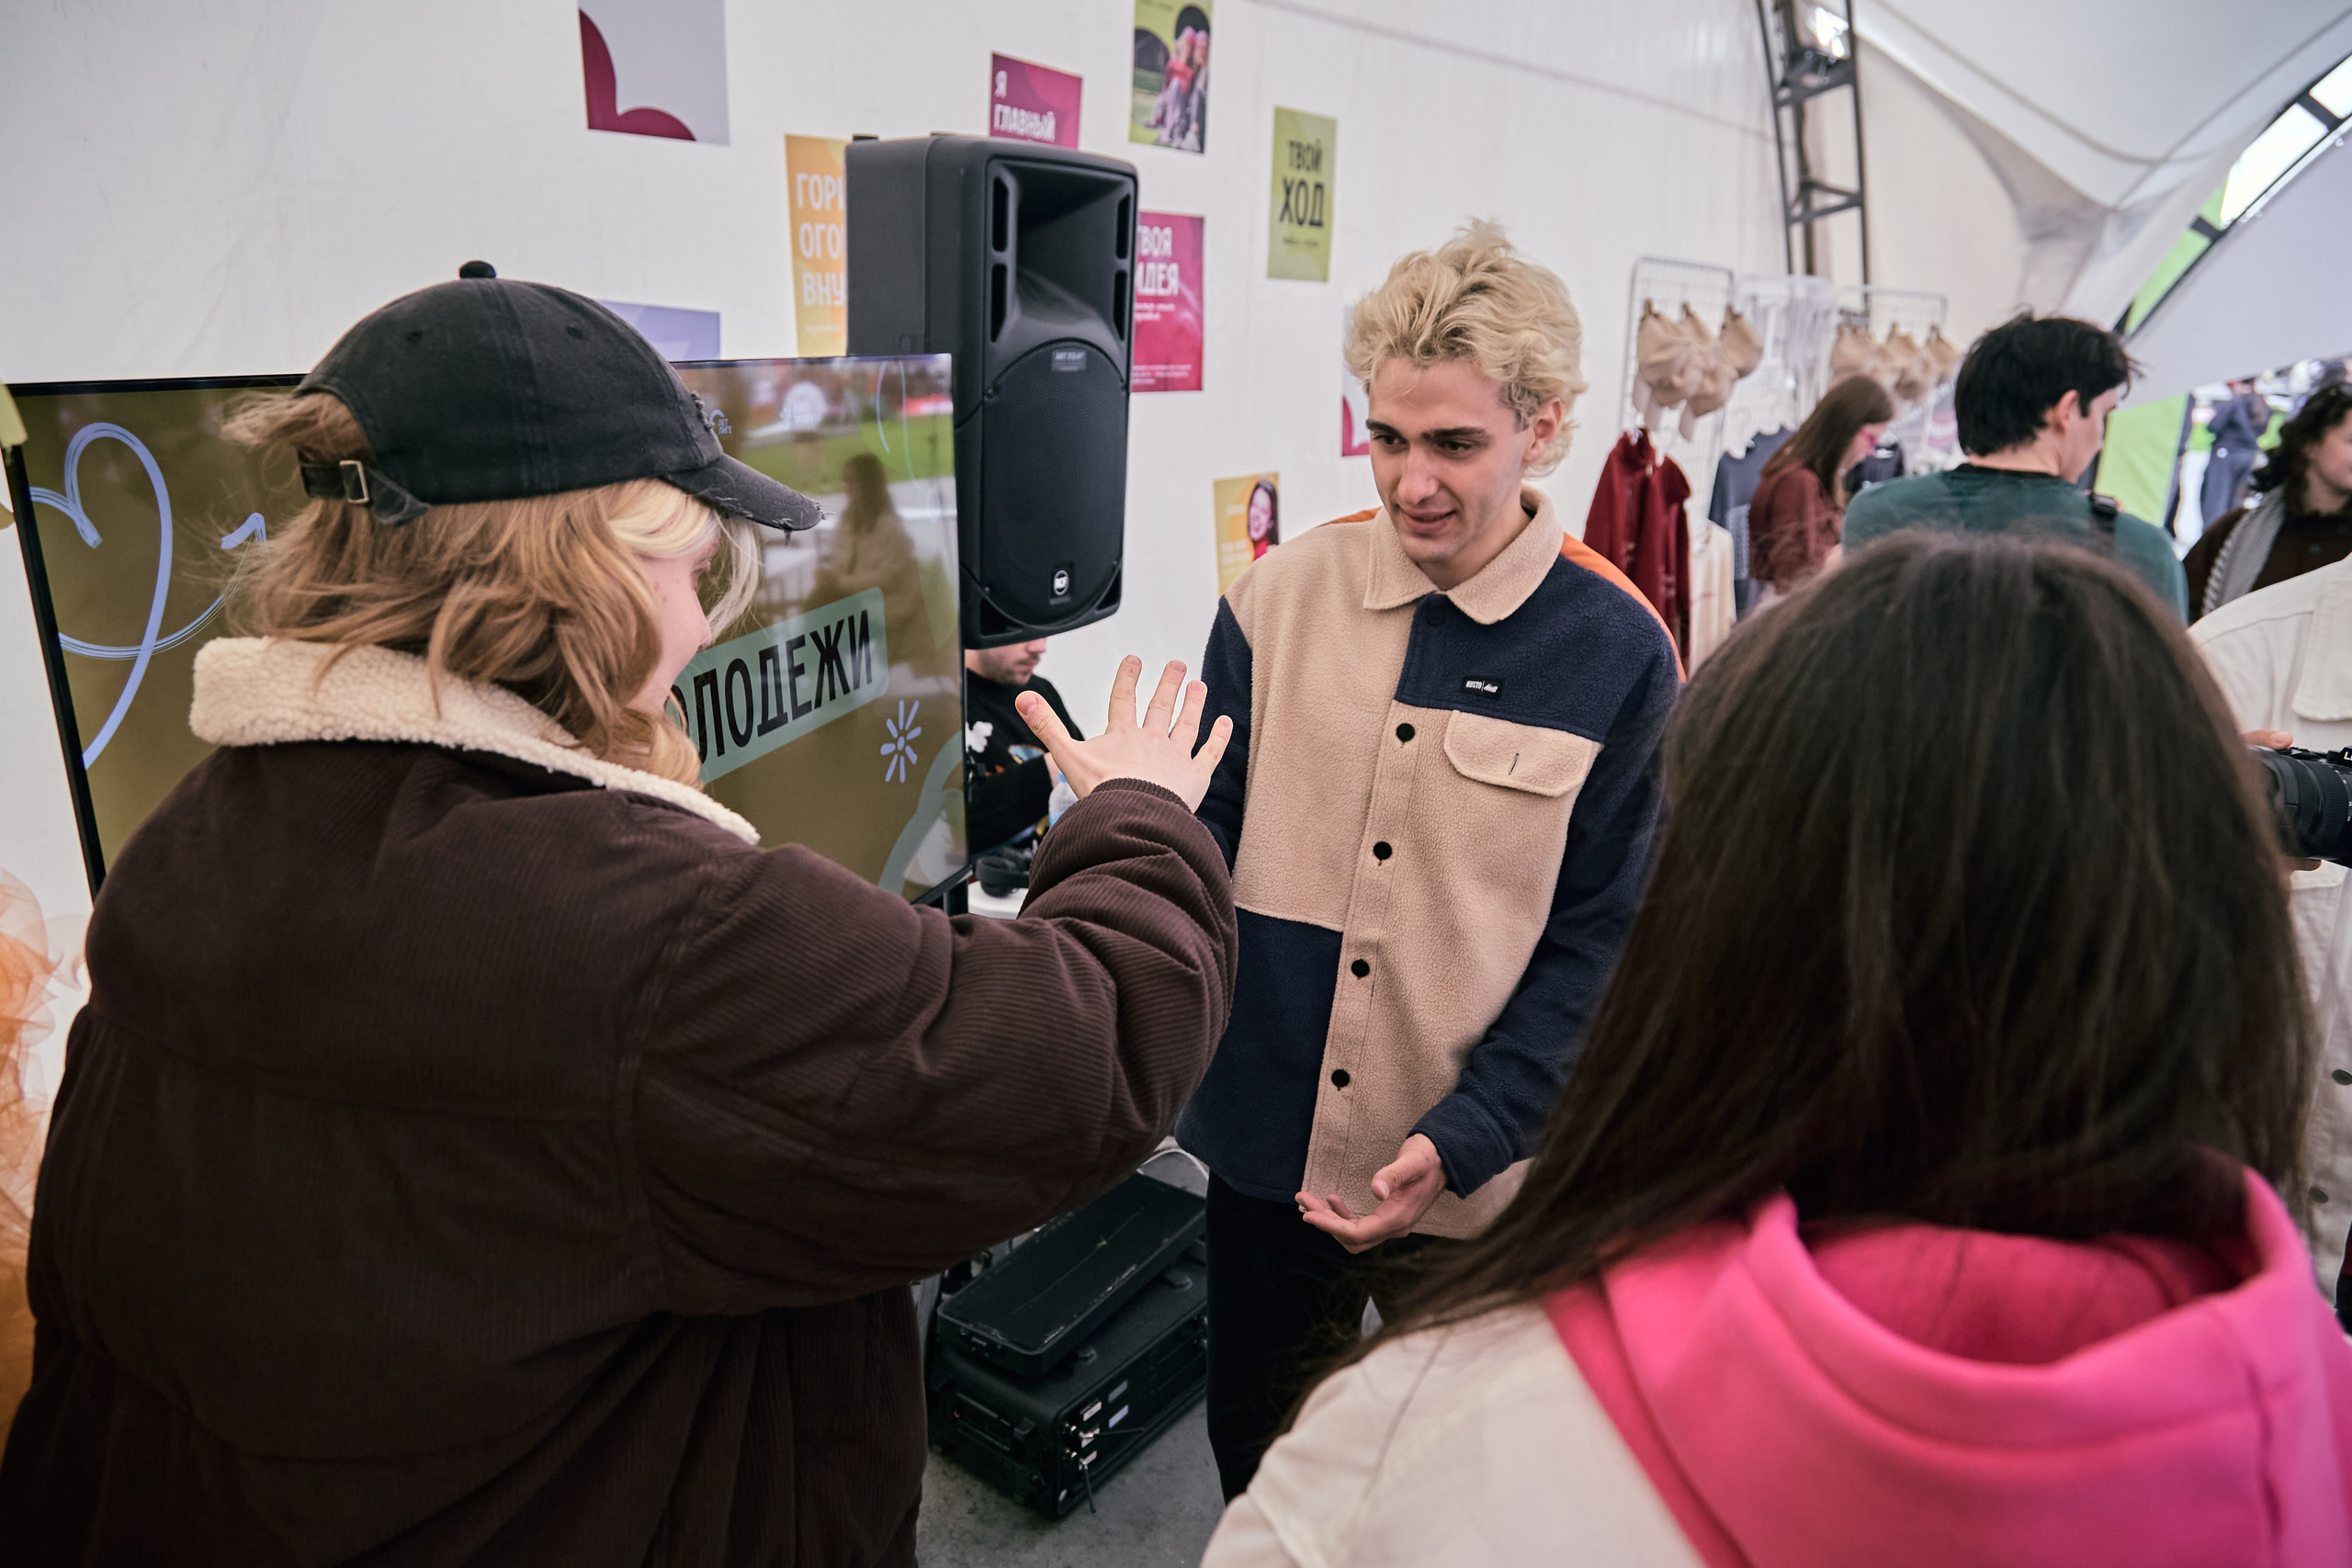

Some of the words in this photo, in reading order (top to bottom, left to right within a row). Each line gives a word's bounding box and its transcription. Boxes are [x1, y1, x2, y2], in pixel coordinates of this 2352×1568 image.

[994, 70, 1008, 98] Я
[994, 103, 1056, 142] ГЛАВНЫЙ
[1288, 139, 1323, 172] ТВОЙ
[1278, 176, 1325, 227] ХОД
[798, 222, 844, 258] ОГО
[2344, 750, 2352, 761] L
